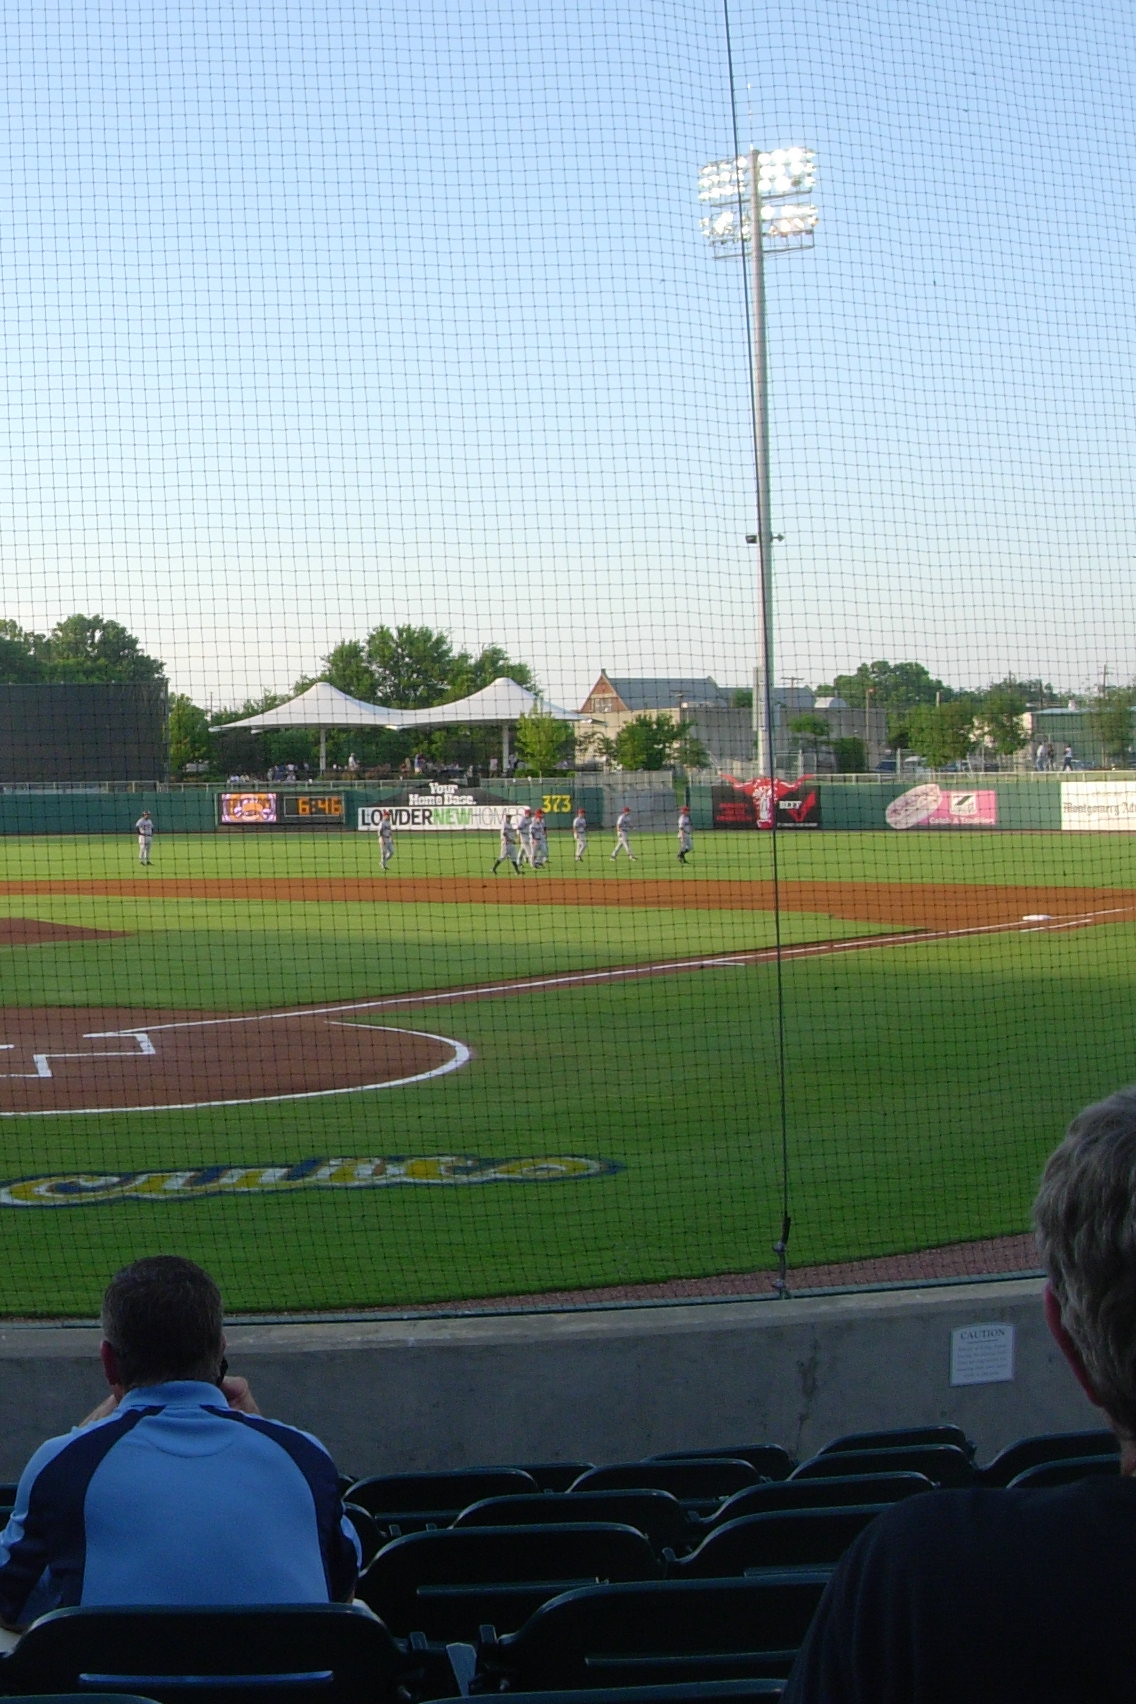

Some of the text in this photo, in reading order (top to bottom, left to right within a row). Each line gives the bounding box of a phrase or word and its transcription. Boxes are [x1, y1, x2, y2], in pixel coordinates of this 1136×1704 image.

[429, 782, 458, 794] Your
[408, 794, 442, 805] Home
[542, 795, 572, 812] 373
[298, 797, 342, 816] 6:46
[960, 1328, 1005, 1340] CAUTION
